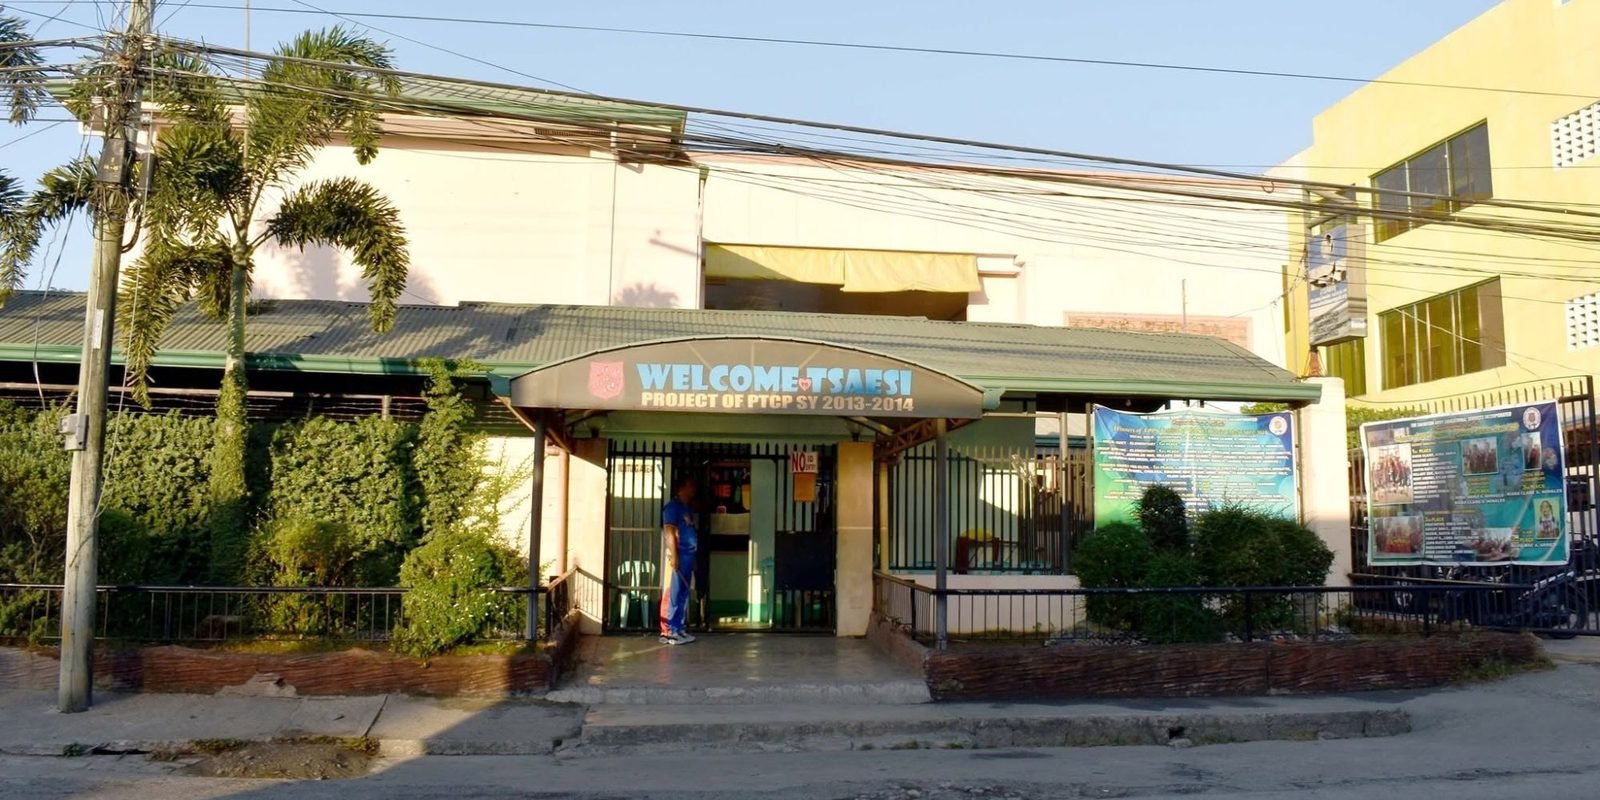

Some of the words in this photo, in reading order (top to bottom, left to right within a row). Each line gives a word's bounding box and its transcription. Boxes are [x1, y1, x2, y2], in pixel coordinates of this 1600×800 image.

[636, 363, 799, 392] WELCOME
[807, 367, 912, 395] TSAESI
[641, 392, 718, 408] PROJECT
[722, 394, 746, 408] OF
[749, 394, 793, 409] PTCP
[796, 395, 818, 410] SY
[822, 396, 914, 411] 2013-2014
[792, 452, 806, 471] NO
